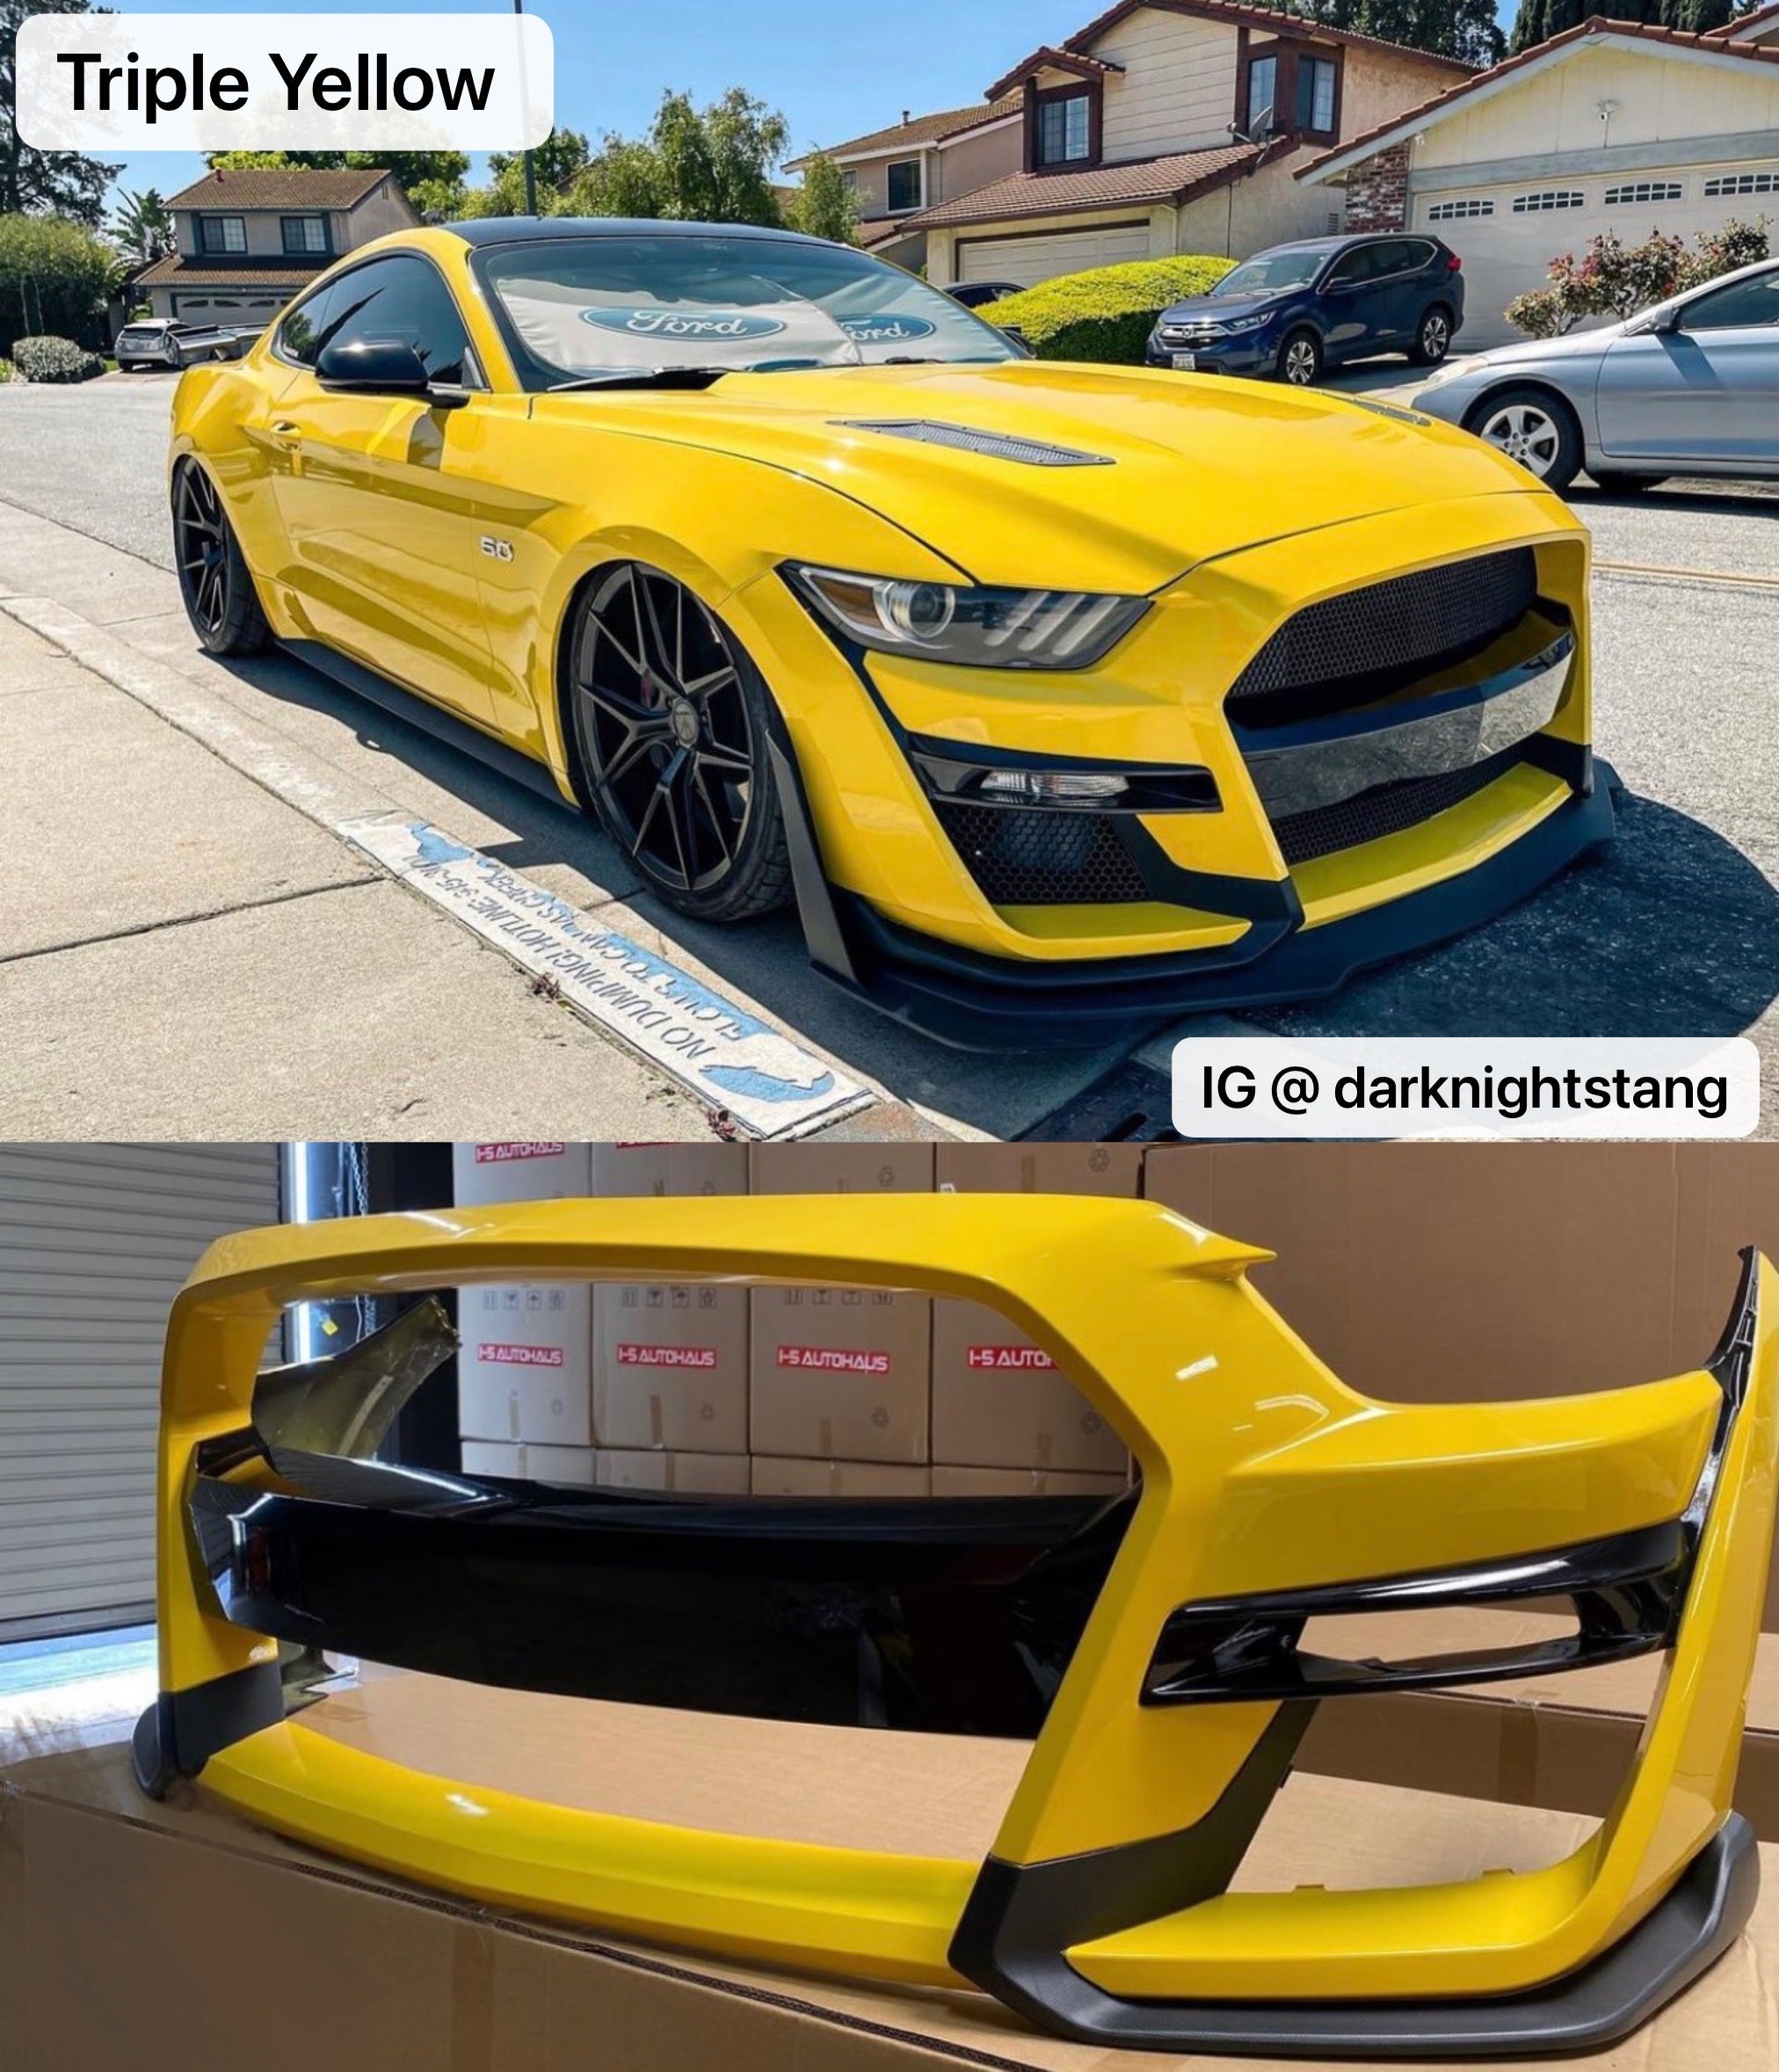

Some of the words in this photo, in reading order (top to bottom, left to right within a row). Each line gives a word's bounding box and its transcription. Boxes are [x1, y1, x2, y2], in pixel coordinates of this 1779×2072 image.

[627, 310, 748, 335] Ford
[545, 949, 672, 1029] DUMPING!
[659, 1026, 716, 1059] NO
[496, 1142, 563, 1158] AUTOHAUS
[496, 1348, 562, 1363] AUTOHAUS
[638, 1349, 715, 1366] AUTOHAUS
[801, 1349, 890, 1372] AUTOHAUS
